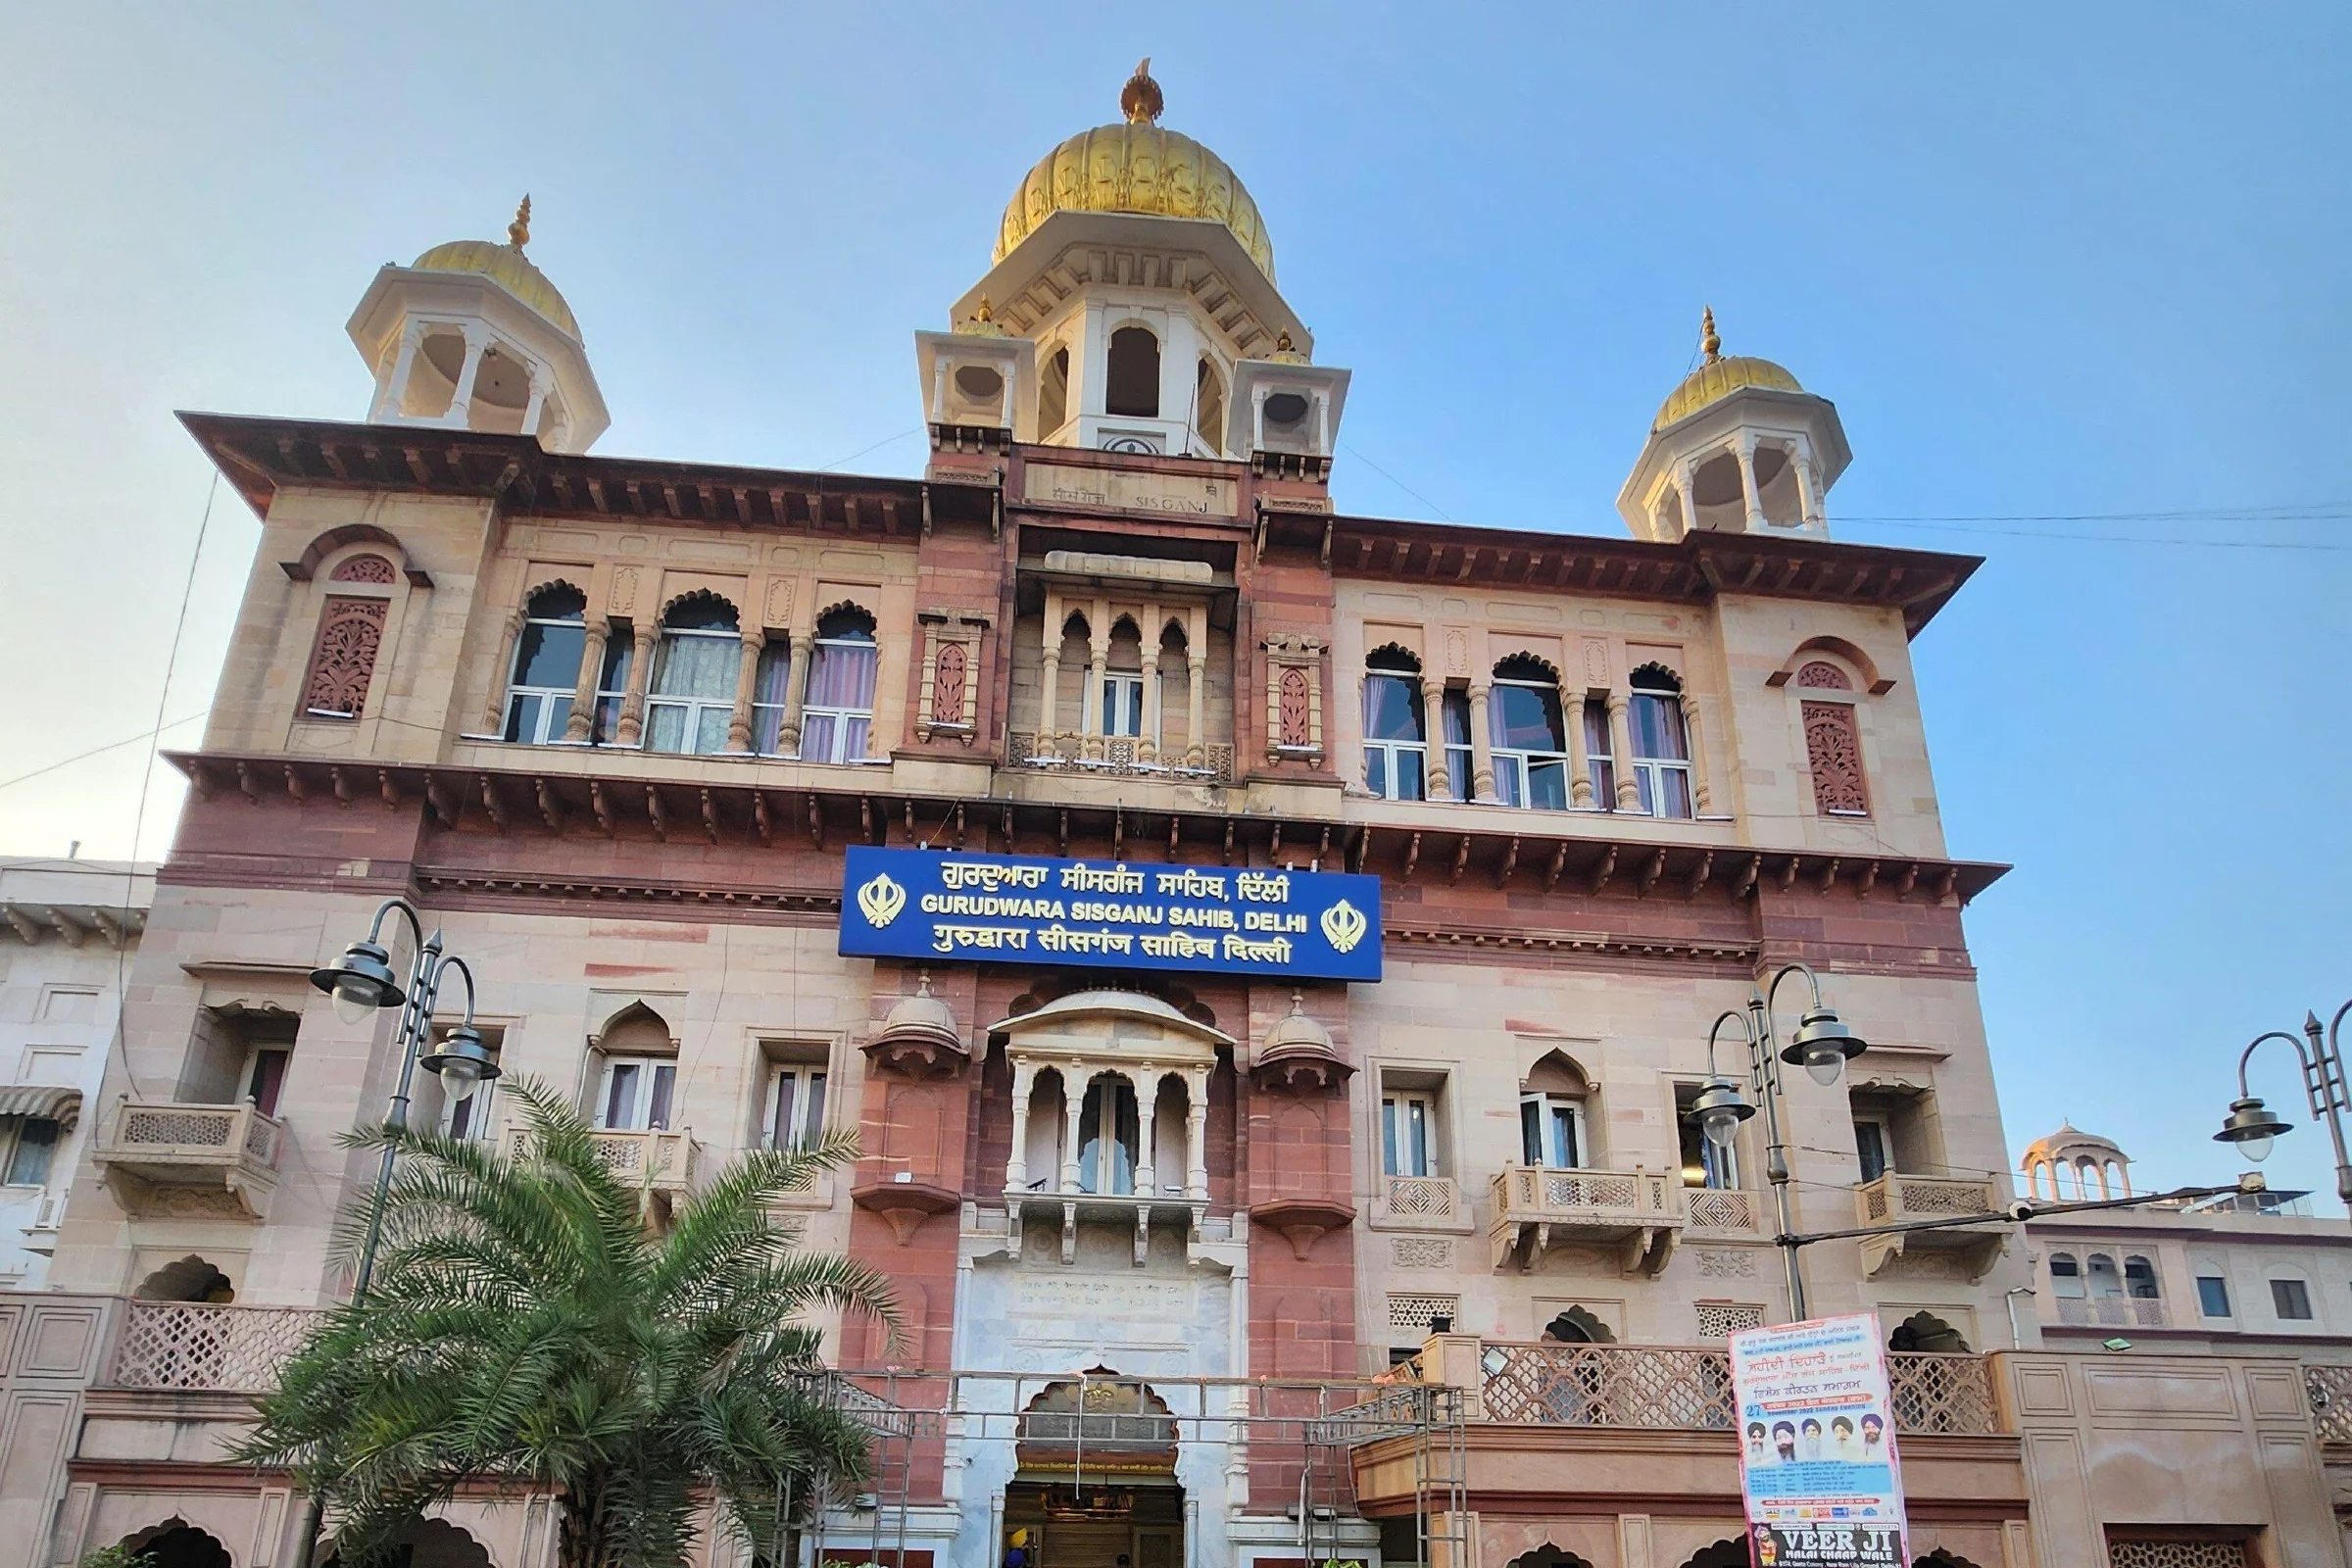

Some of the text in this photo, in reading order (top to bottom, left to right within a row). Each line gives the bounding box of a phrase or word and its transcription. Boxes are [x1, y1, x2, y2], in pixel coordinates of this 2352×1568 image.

[941, 861, 1290, 904] ਗੁਰਦੁਆਰਾ ਸੀਸਗੰਜ ਸਾਹਿਬ, ਦਿੱਲੀ
[921, 894, 1306, 933] GURUDWARA SISGANJ SAHIB, DELHI
[932, 923, 1293, 963] गुरुद्वारा सीसगंज साहिब दिल्ली
[1746, 1404, 1761, 1417] 27
[1782, 1531, 1892, 1551] VEER JI
[1786, 1550, 1893, 1561] MALAI CHAAP WALE
